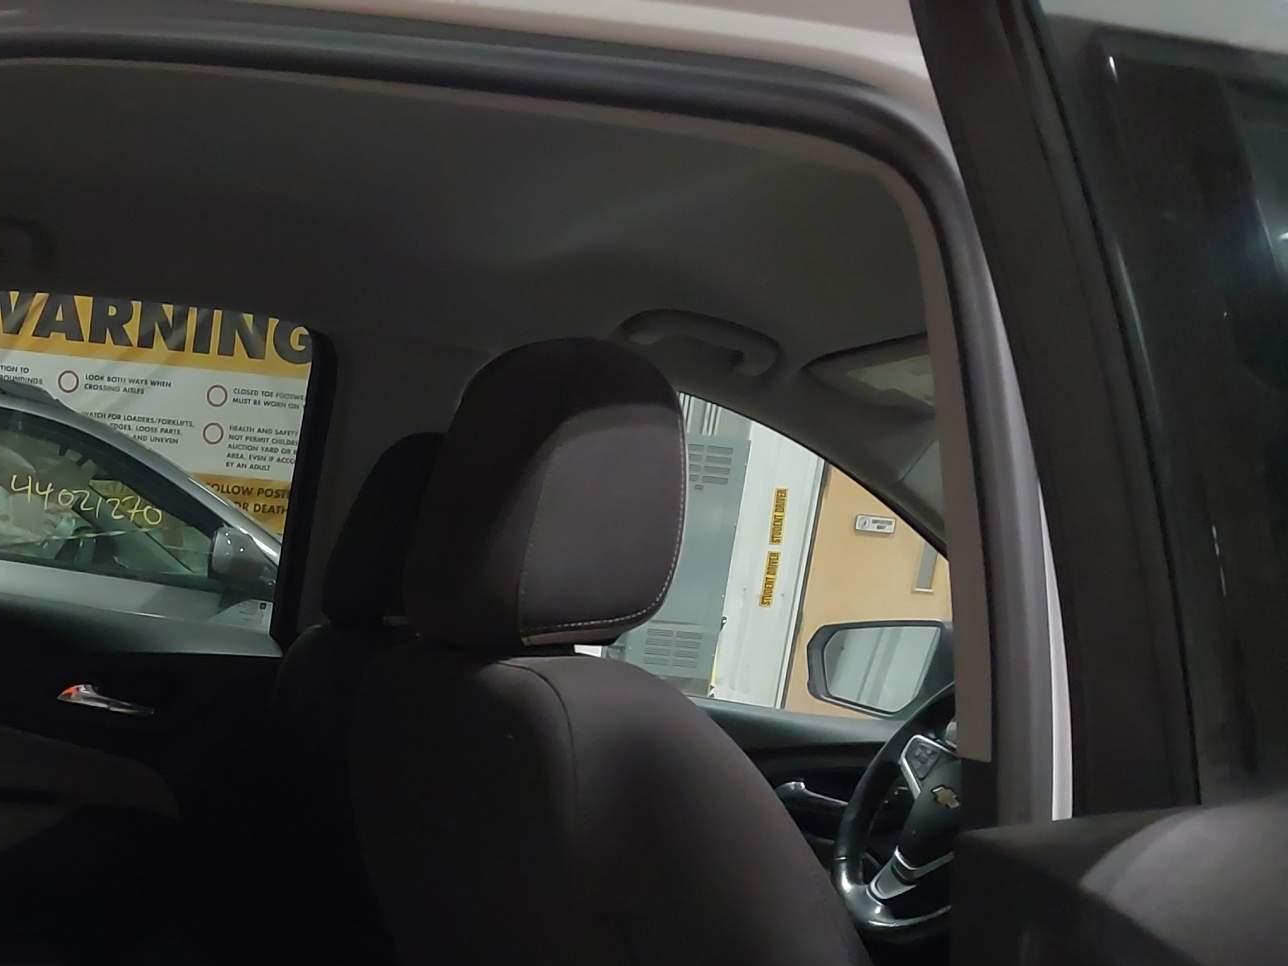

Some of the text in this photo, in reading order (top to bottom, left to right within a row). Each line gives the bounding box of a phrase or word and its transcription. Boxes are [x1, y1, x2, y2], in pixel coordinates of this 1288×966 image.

[20, 366, 30, 374] TO
[150, 380, 172, 388] WHEN
[84, 383, 144, 395] CROSSING AISLES
[233, 388, 259, 396] CLOSED
[136, 425, 157, 433] LOOSE
[229, 425, 254, 433] HEALTH
[150, 436, 178, 444] UNEVEN
[227, 443, 259, 452] AUCTION
[261, 446, 279, 454] YARD
[10, 475, 162, 525] 44021270
[771, 488, 788, 545] STUDENT DRIVER
[760, 551, 781, 607] STUDENT DRIVER
